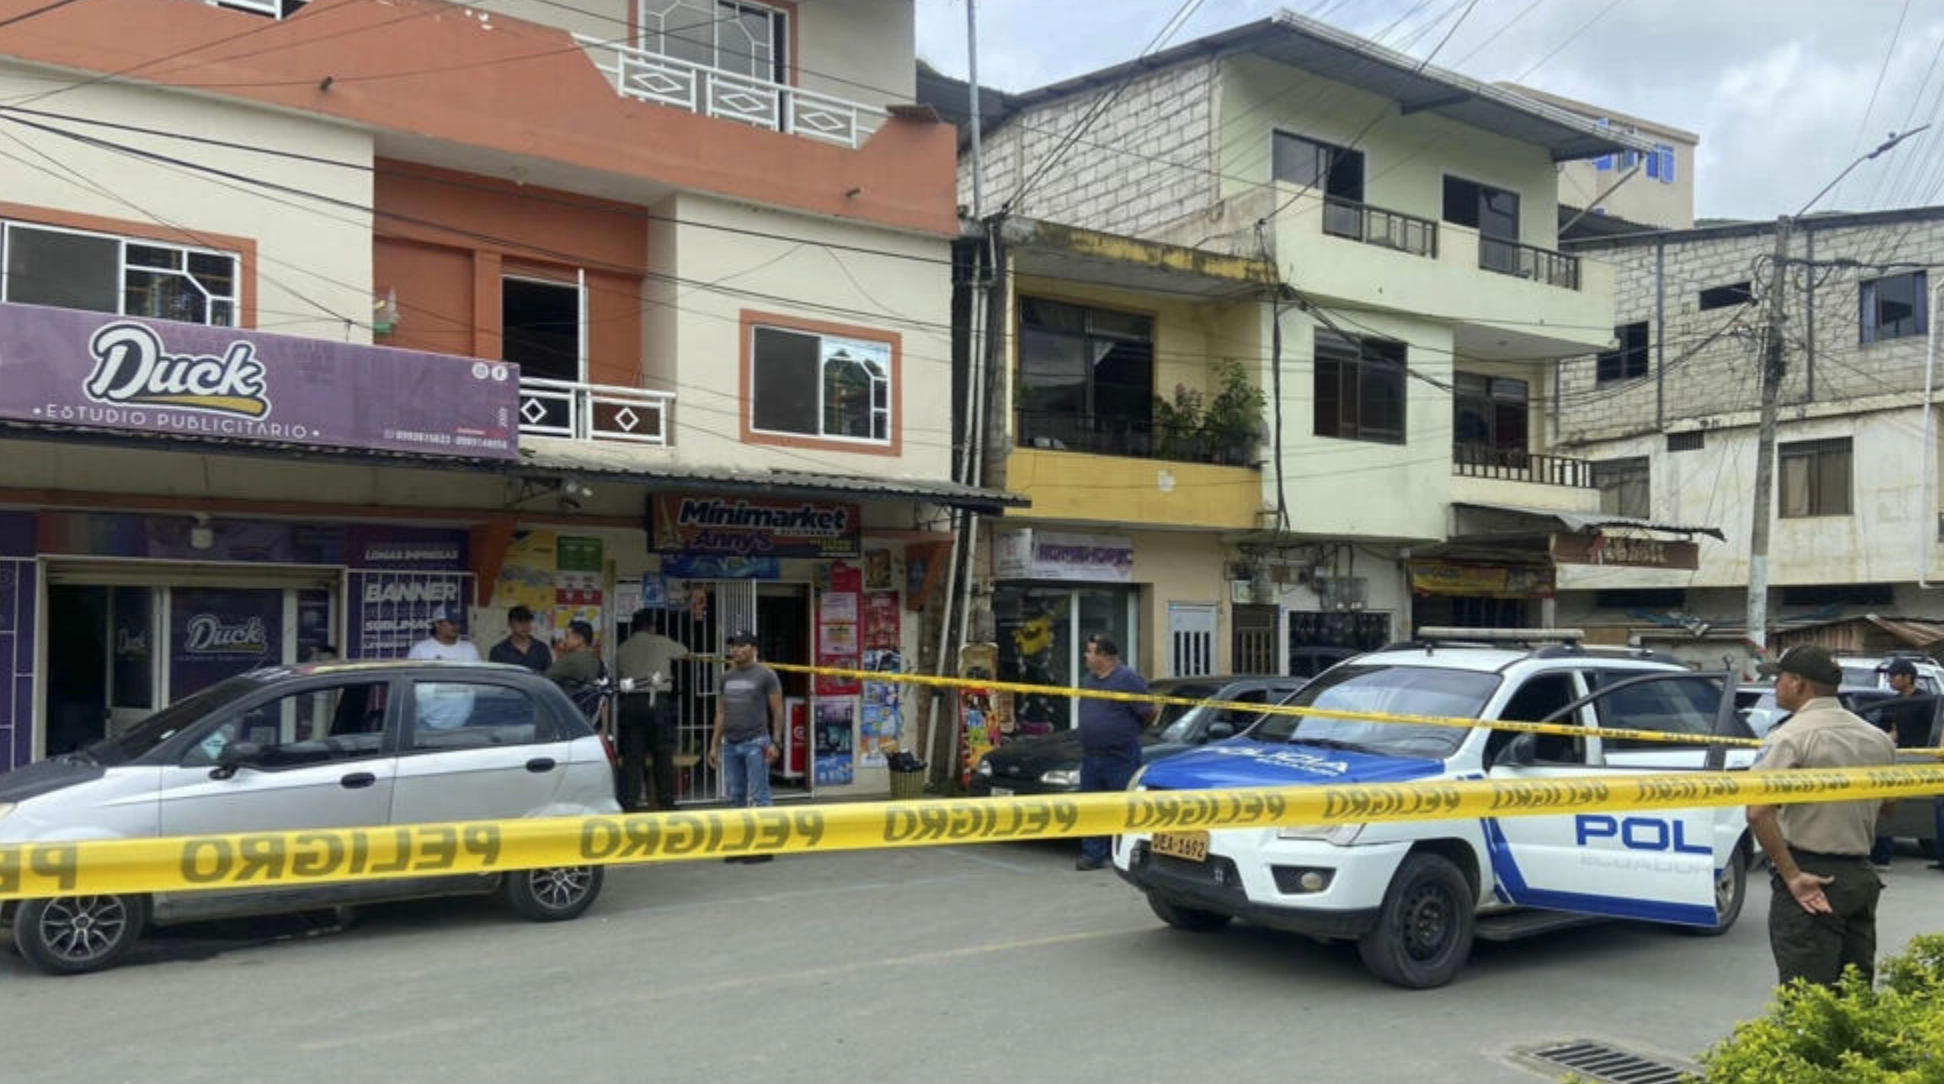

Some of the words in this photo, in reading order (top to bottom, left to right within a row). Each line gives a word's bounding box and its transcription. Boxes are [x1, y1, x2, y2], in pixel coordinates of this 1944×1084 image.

[86, 323, 265, 402] Duck
[46, 403, 146, 425] ESTUDIO
[157, 413, 307, 438] PUBLICITARIO
[679, 498, 846, 531] Minimarket
[364, 581, 457, 602] BANNER
[187, 616, 264, 651] Duck
[1576, 814, 1713, 855] POL
